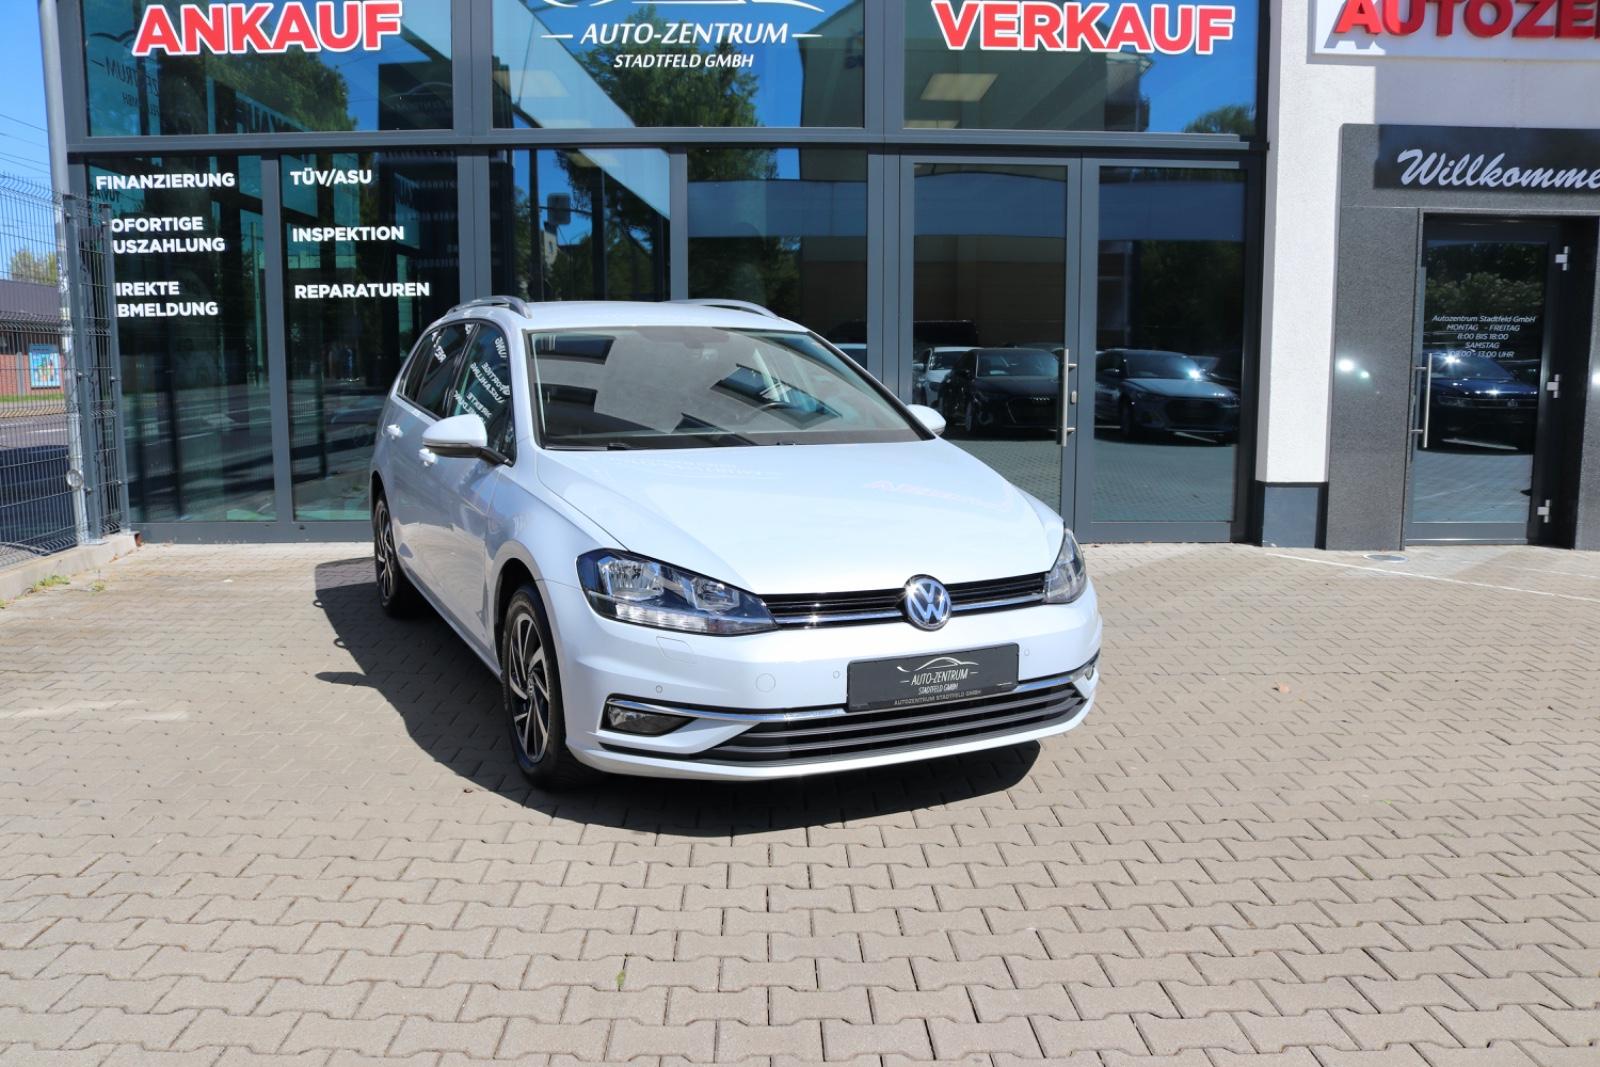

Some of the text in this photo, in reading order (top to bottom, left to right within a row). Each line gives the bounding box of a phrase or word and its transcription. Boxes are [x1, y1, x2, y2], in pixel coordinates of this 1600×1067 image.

[931, 0, 1236, 54] VERKAUF
[1333, 0, 1600, 39] AUTOZE
[132, 0, 403, 57] ANKAUF
[580, 23, 788, 44] AUTO-ZENTRUM
[613, 54, 754, 68] STADTFELD GMBH
[95, 173, 236, 190] FINANZIERUNG
[290, 167, 372, 187] TÜV/ASU
[111, 216, 204, 233] OFORTIGE
[292, 226, 405, 242] INSPEKTION
[112, 237, 226, 254] USZAHLUNG
[113, 281, 180, 297] IREKTE
[294, 282, 430, 299] REPARATUREN
[115, 301, 219, 318] BMELDUNG
[1498, 350, 1515, 358] UHR
[910, 668, 969, 686] AUTO-ZENTRUM
